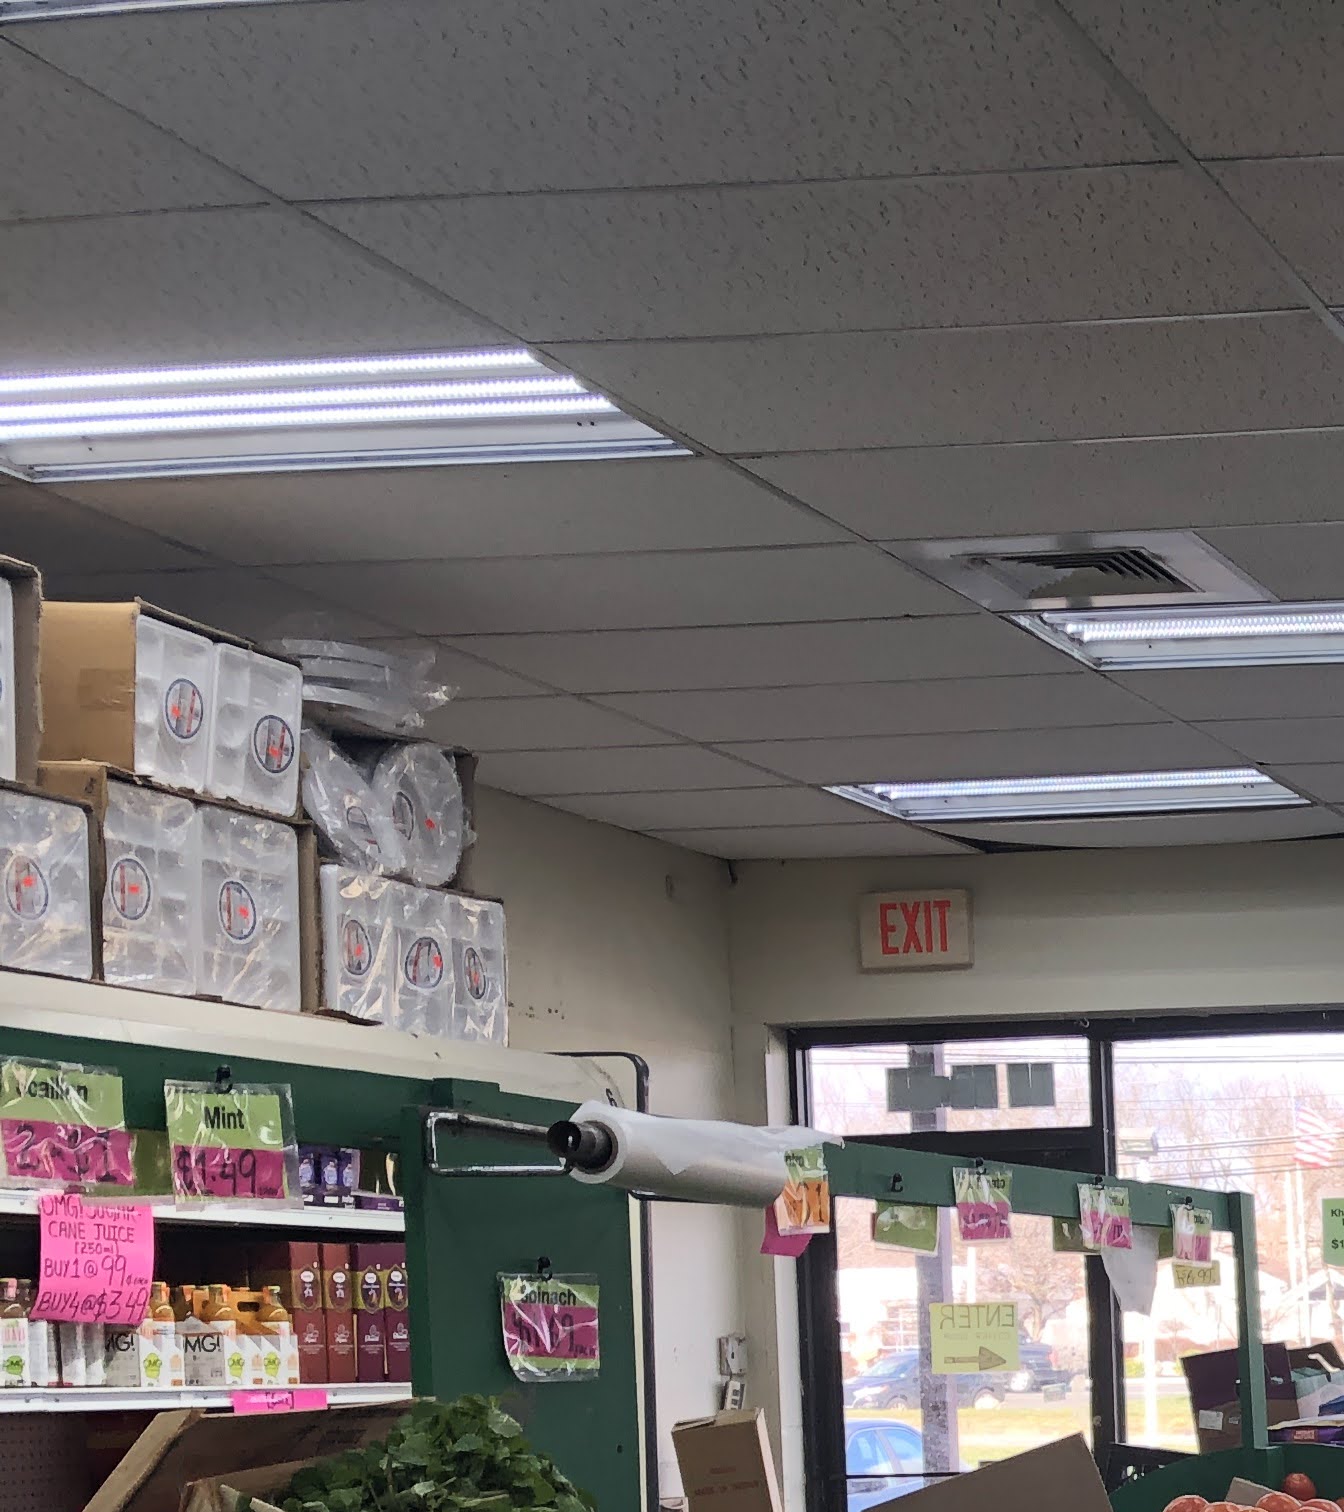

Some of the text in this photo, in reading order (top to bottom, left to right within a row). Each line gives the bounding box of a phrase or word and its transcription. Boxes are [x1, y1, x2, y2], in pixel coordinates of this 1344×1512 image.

[879, 900, 951, 955] EXIT
[204, 1105, 245, 1130] Mint
[47, 1220, 135, 1244] CANE JUICE
[43, 1256, 69, 1280] BUY
[83, 1260, 98, 1279] @
[36, 1290, 70, 1314] BUY
